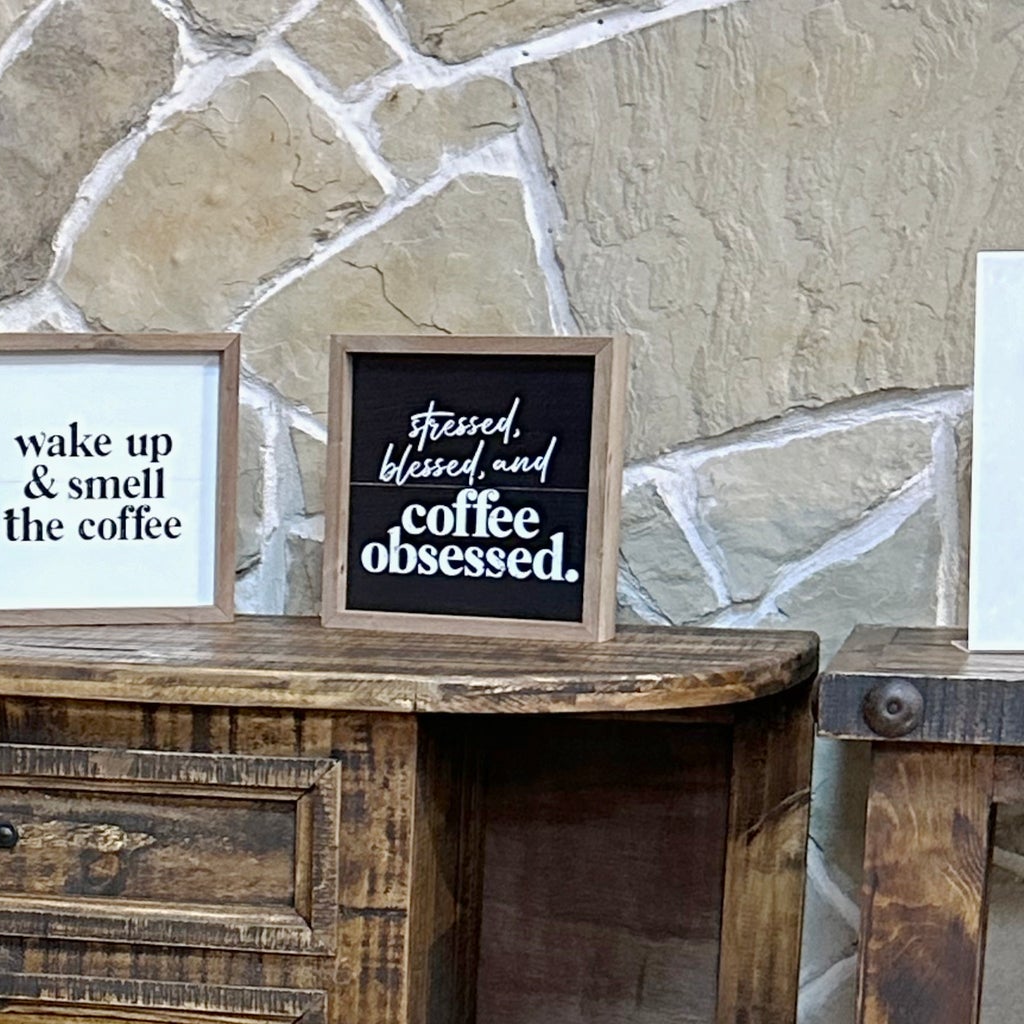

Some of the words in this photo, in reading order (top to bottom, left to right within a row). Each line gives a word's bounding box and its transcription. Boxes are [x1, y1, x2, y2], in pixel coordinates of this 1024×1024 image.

[14, 421, 113, 458] wake
[126, 432, 173, 463] up
[408, 397, 521, 452] stressed,
[23, 464, 58, 500] &
[67, 466, 165, 500] smell
[378, 439, 486, 486] blessed,
[492, 436, 557, 483] and
[3, 506, 64, 542] the
[78, 504, 182, 541] coffee
[401, 488, 540, 538] coffee
[361, 526, 579, 583] obsessed.
